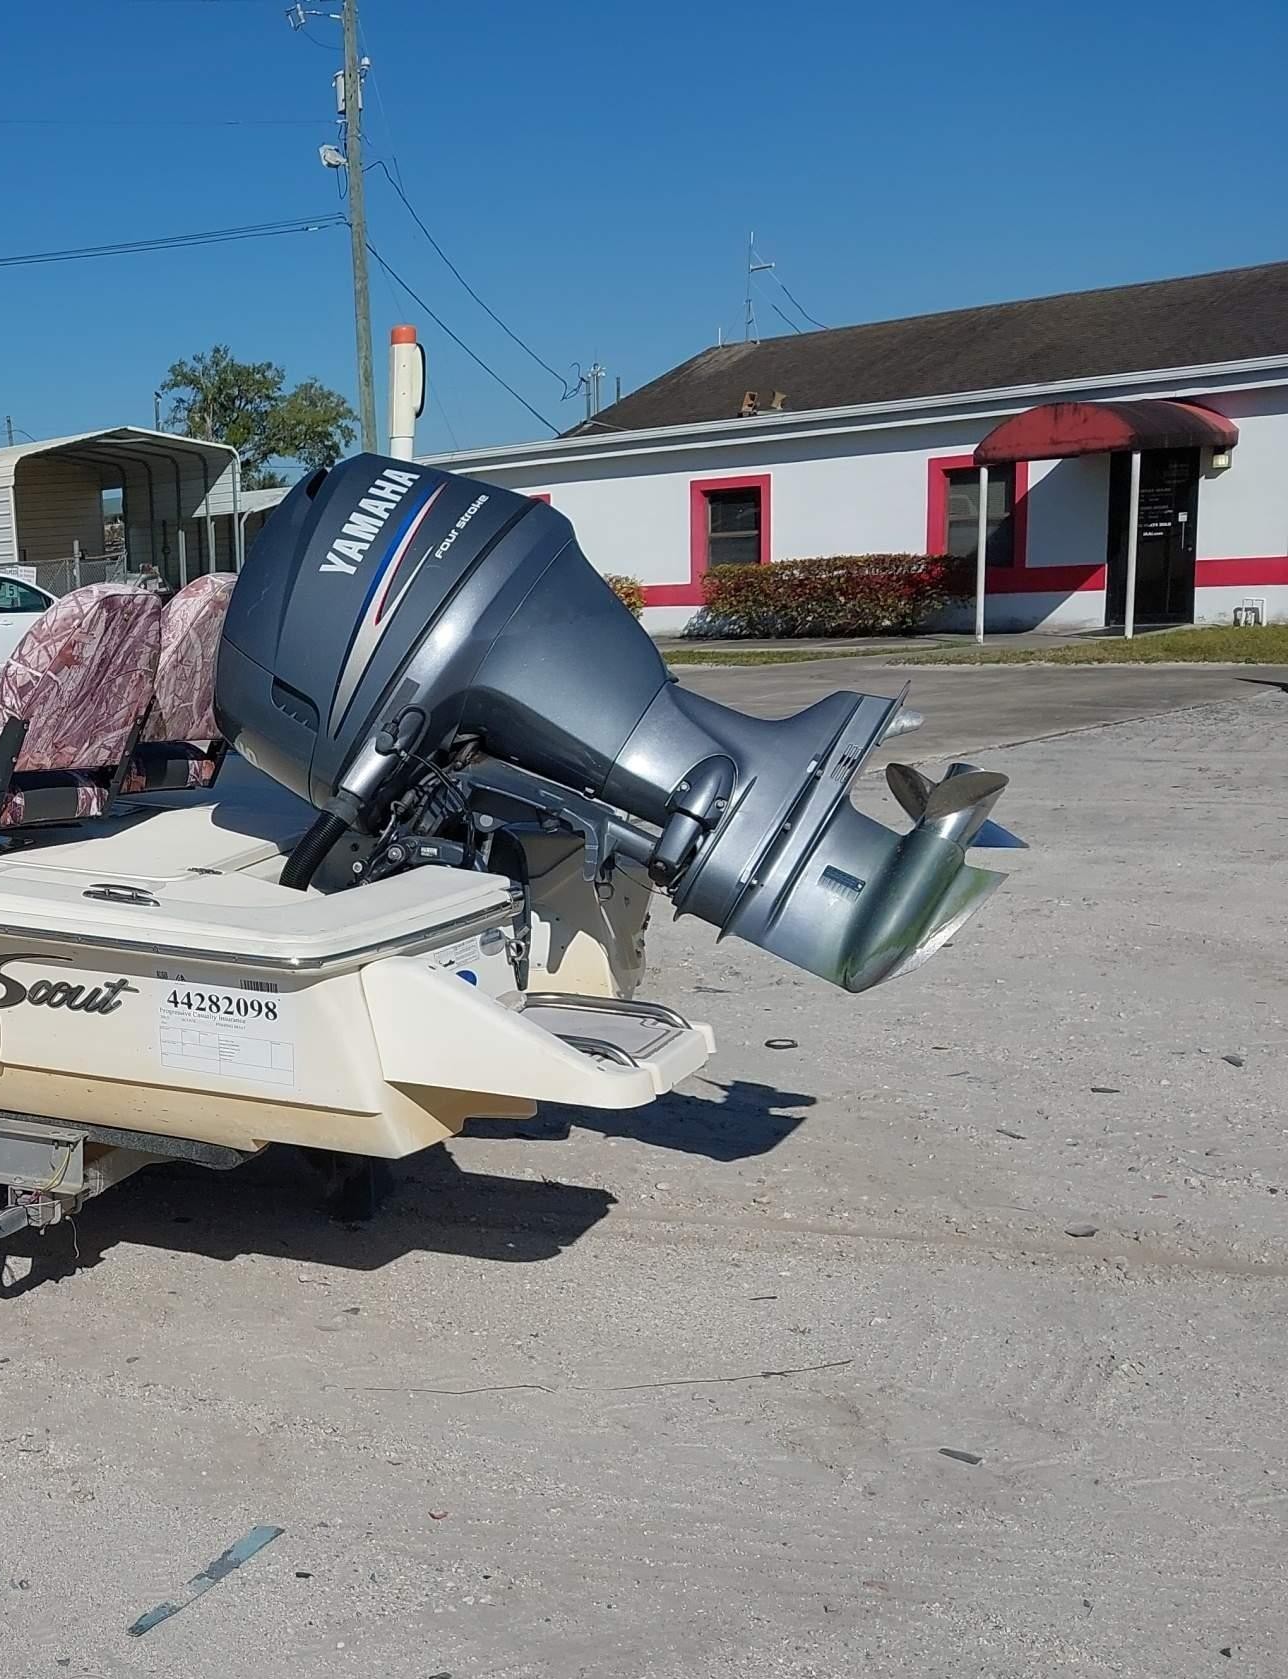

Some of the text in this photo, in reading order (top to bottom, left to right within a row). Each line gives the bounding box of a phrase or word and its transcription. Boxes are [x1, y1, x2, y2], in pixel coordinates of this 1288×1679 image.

[318, 468, 422, 576] YAMAHA
[159, 1007, 192, 1018] Progressive
[192, 1010, 218, 1022] Casualty
[218, 1013, 247, 1025] Insurance
[166, 989, 279, 1021] 44282098
